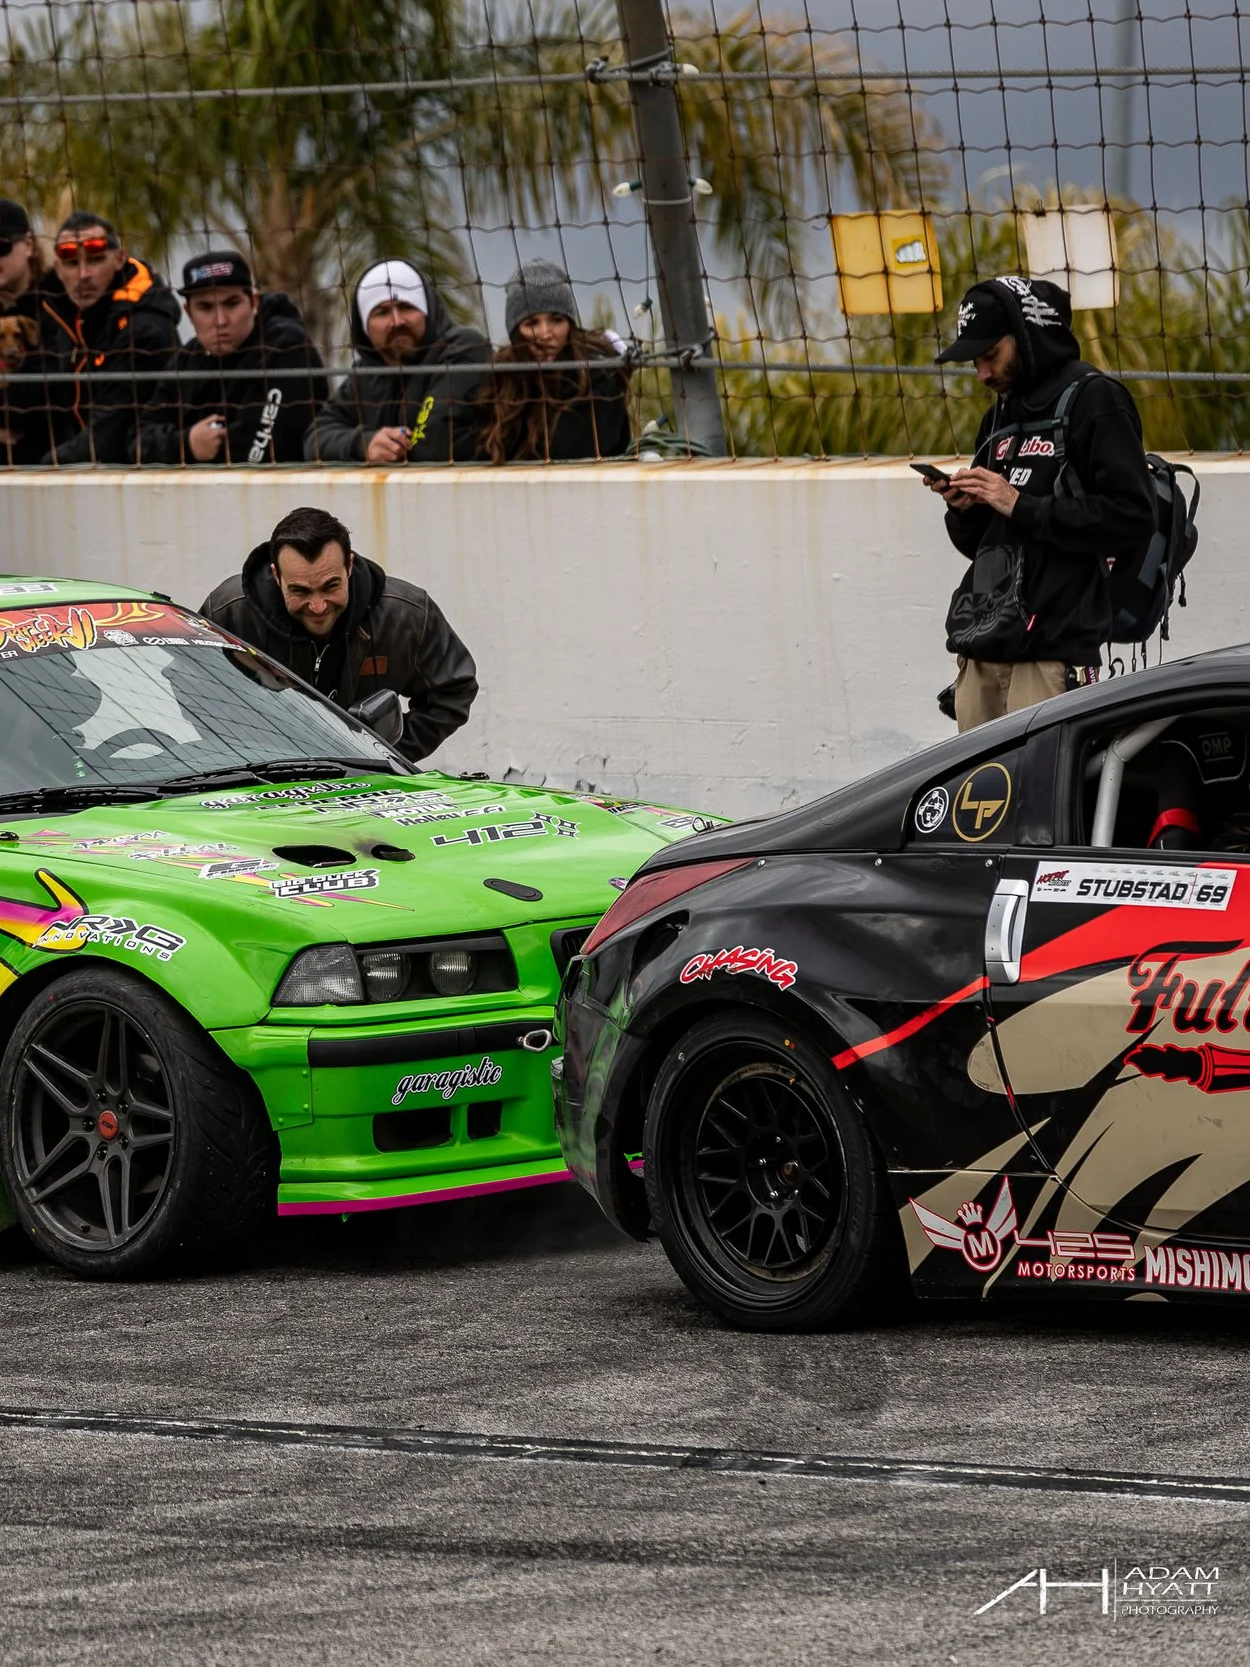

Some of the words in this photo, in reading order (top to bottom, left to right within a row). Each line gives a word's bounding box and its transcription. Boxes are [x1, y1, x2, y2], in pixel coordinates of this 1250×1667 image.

[1202, 736, 1232, 757] OMP
[432, 821, 548, 847] 412
[280, 877, 371, 896] CLUB
[1076, 878, 1189, 901] STUBSTAD
[1196, 885, 1229, 903] 69
[391, 1055, 503, 1106] garagistic
[1017, 1261, 1136, 1282] MOTORSPORTS
